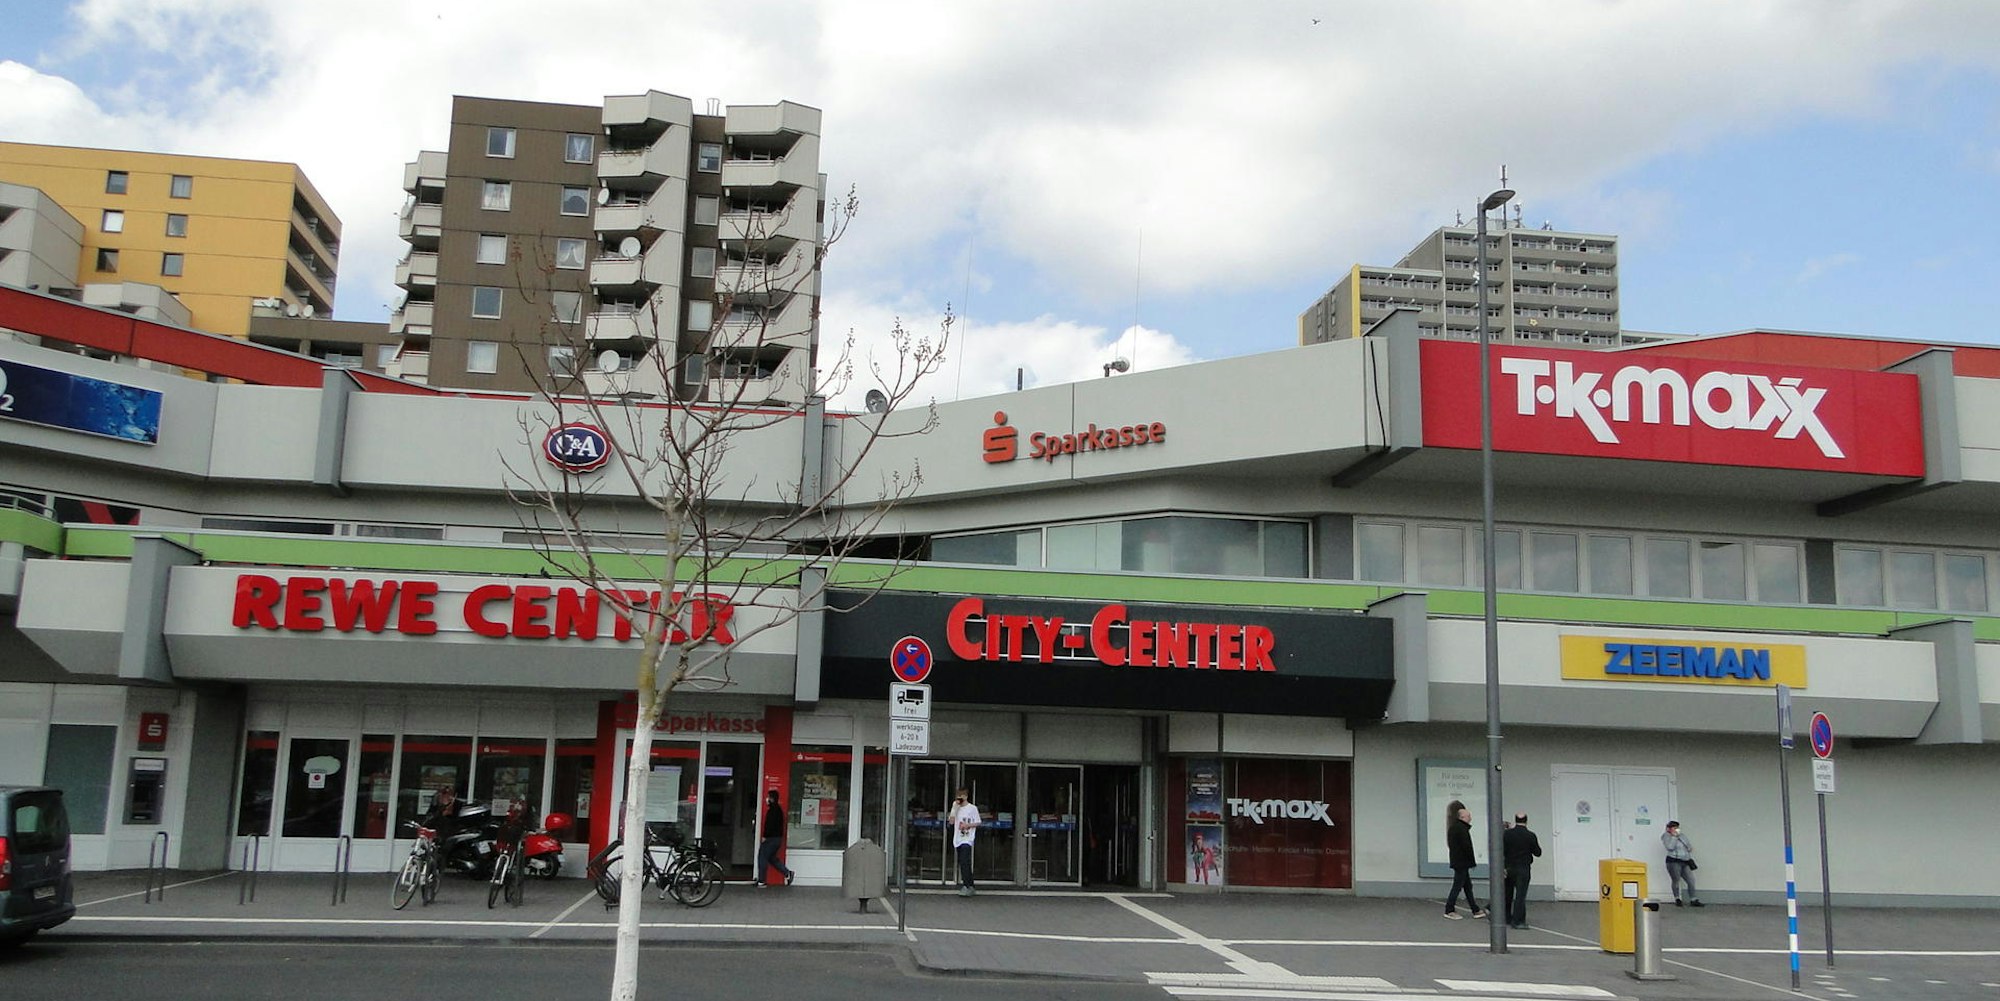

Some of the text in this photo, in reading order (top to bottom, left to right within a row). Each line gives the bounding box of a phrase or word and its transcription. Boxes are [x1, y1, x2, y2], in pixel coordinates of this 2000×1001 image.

[555, 434, 599, 458] C&A
[1029, 422, 1166, 463] Sparkasse
[232, 575, 735, 645] REWE CENTER
[1604, 642, 1771, 681] ZEEMAN
[656, 711, 766, 734] Sparkasse
[904, 706, 917, 715] frei
